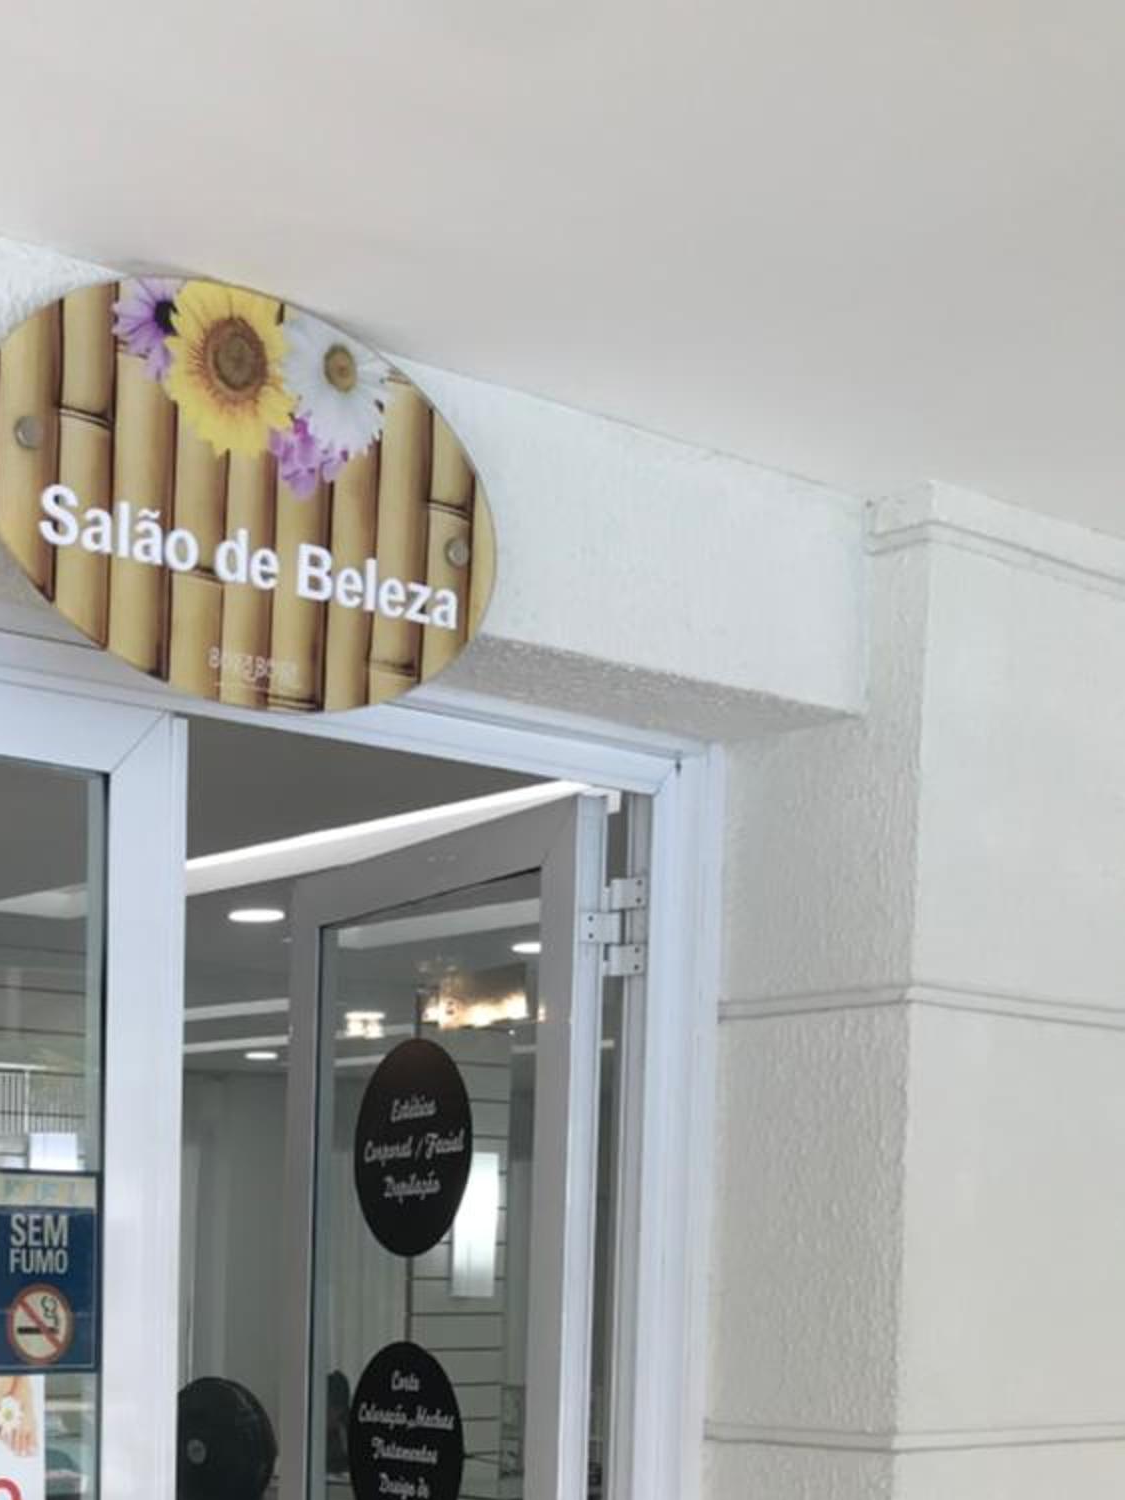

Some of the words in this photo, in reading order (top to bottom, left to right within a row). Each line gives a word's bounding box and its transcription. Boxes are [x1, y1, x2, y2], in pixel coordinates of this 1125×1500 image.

[39, 484, 198, 572] Salão
[214, 529, 279, 589] de
[297, 543, 458, 629] Beleza
[10, 1213, 69, 1248] SEM
[9, 1249, 69, 1275] FUMO
